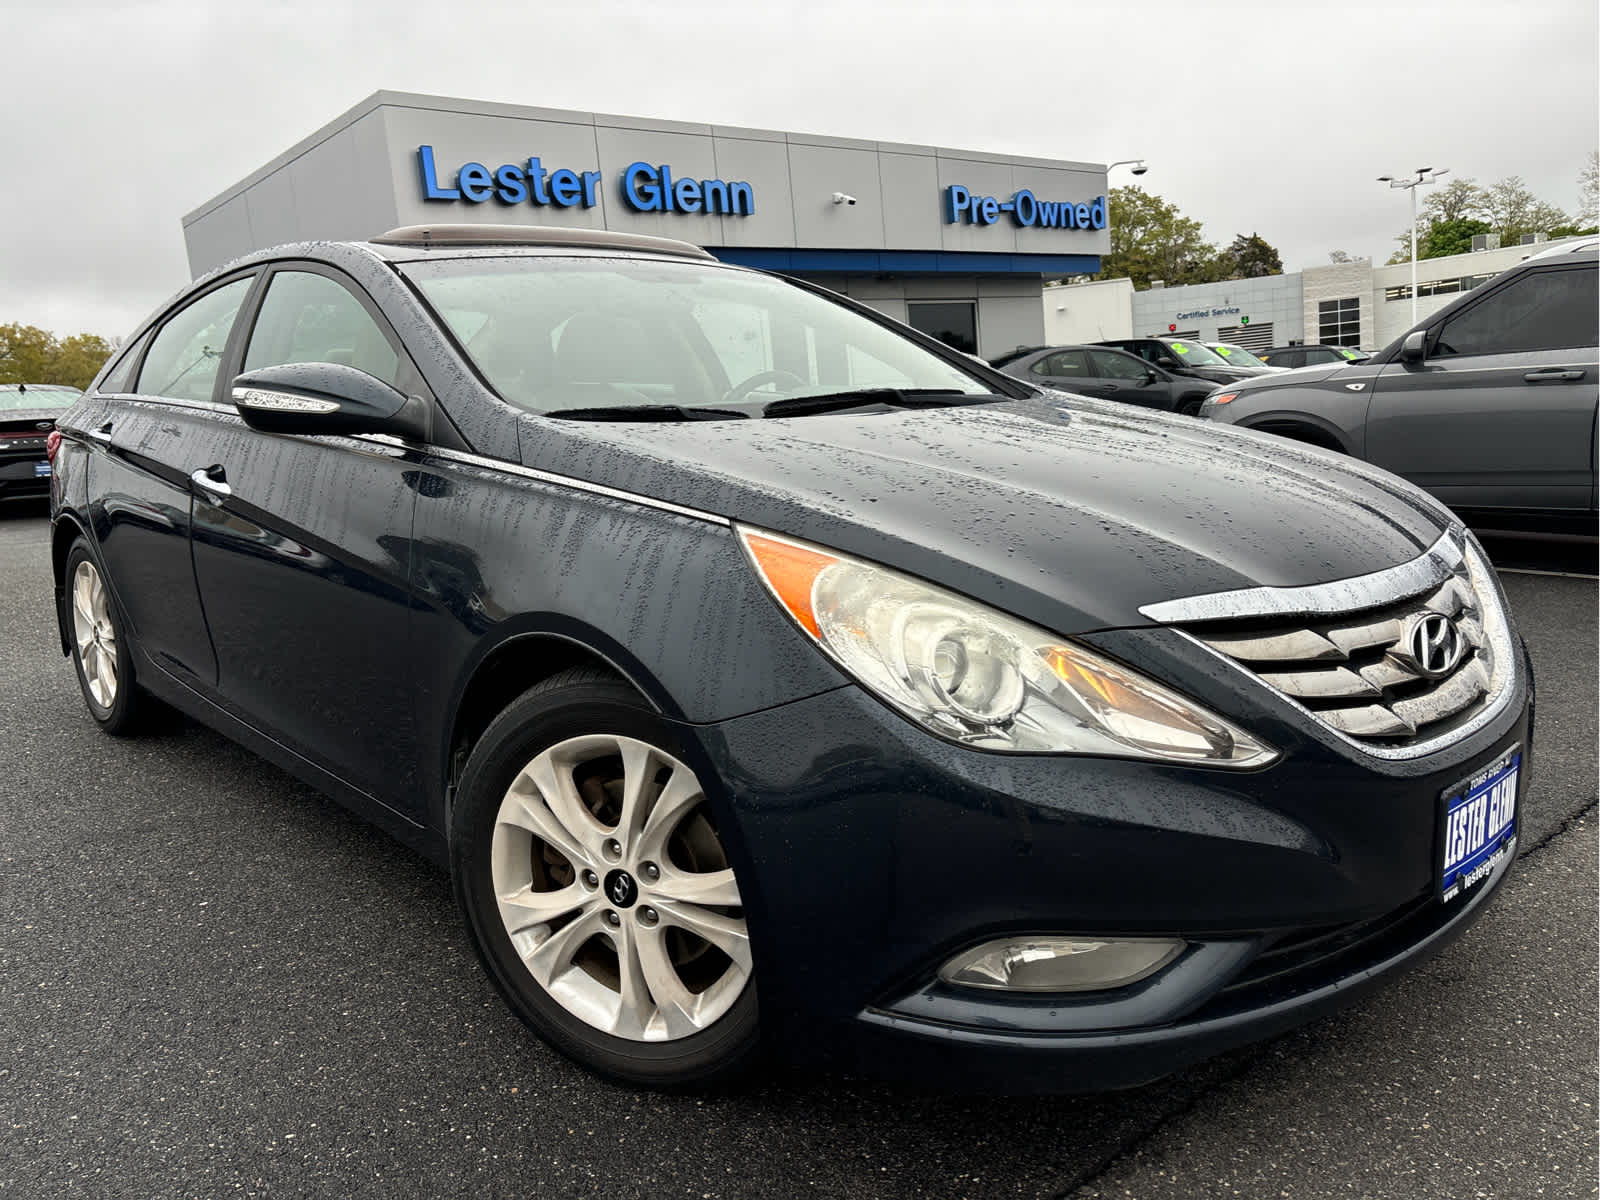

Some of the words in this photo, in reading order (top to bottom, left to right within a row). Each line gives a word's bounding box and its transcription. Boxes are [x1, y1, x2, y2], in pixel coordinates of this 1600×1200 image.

[416, 145, 601, 208] Lester
[622, 161, 755, 216] Glenn
[944, 184, 1107, 230] Pre-Owned
[1176, 312, 1209, 320] Certified
[1212, 307, 1240, 316] Service
[1444, 794, 1487, 869] LESTER
[1489, 770, 1518, 839] GLENN
